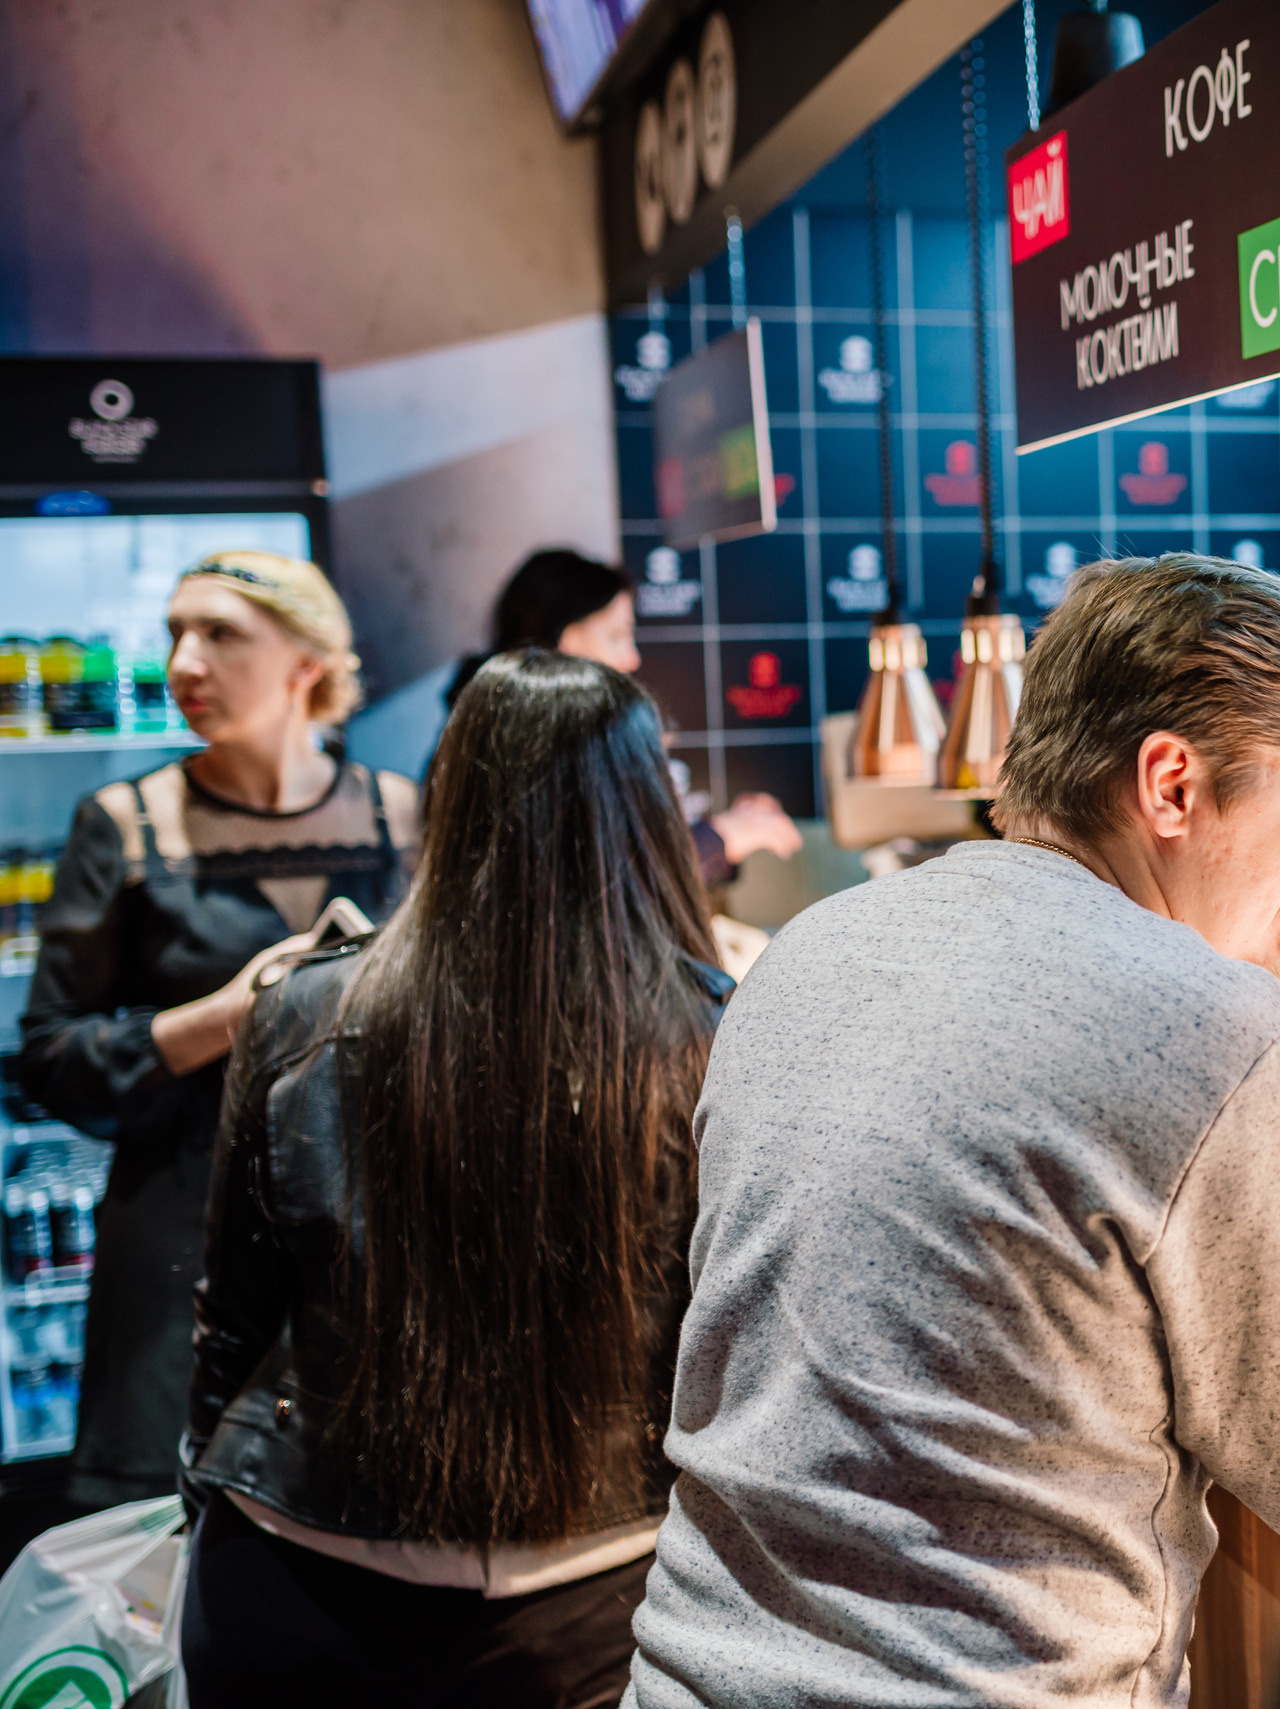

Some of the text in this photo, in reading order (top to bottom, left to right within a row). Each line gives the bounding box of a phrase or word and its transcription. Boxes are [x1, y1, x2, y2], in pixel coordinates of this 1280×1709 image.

[1164, 39, 1252, 158] КОФЕ
[1013, 139, 1065, 240] ЧАЙ
[1060, 219, 1195, 330] МОЛОЧНЫЕ
[1076, 296, 1180, 390] КОКТЕЙЛИ
